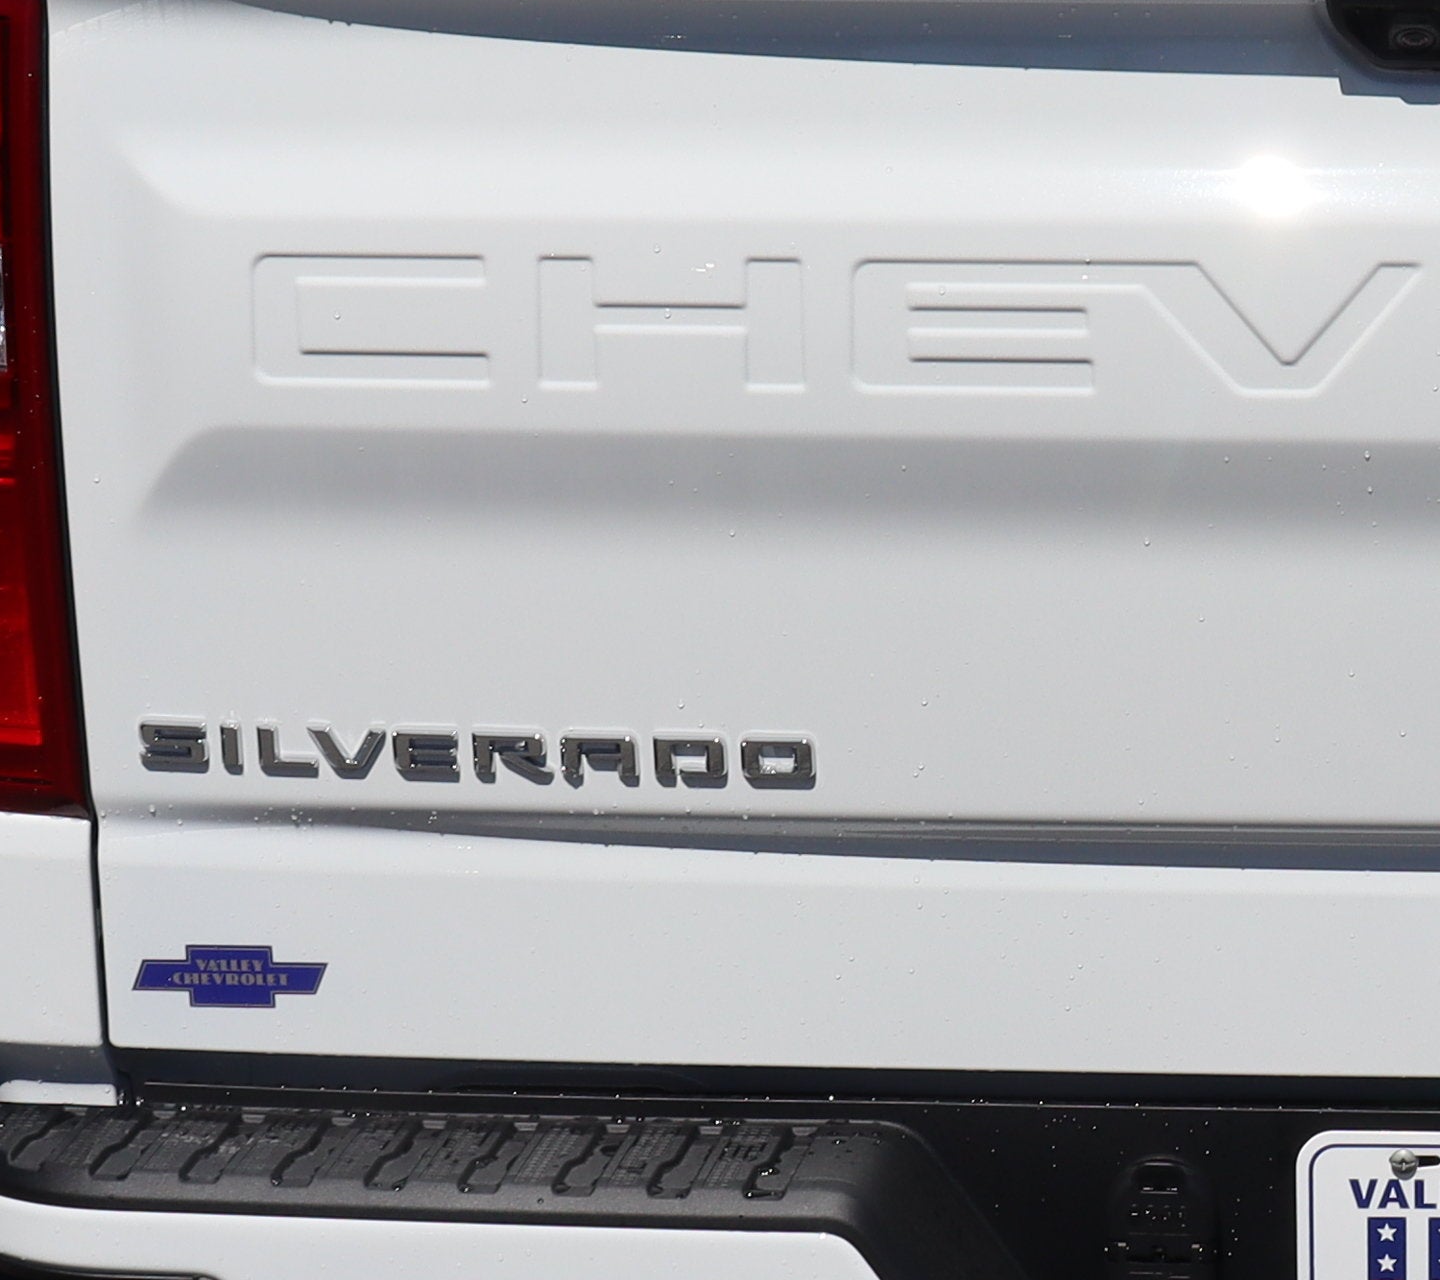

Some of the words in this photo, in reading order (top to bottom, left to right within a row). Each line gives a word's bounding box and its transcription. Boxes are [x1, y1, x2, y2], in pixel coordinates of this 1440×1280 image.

[139, 720, 817, 789] SILVERADO
[196, 958, 265, 973] VALLEY
[172, 971, 289, 987] CHEVROLET
